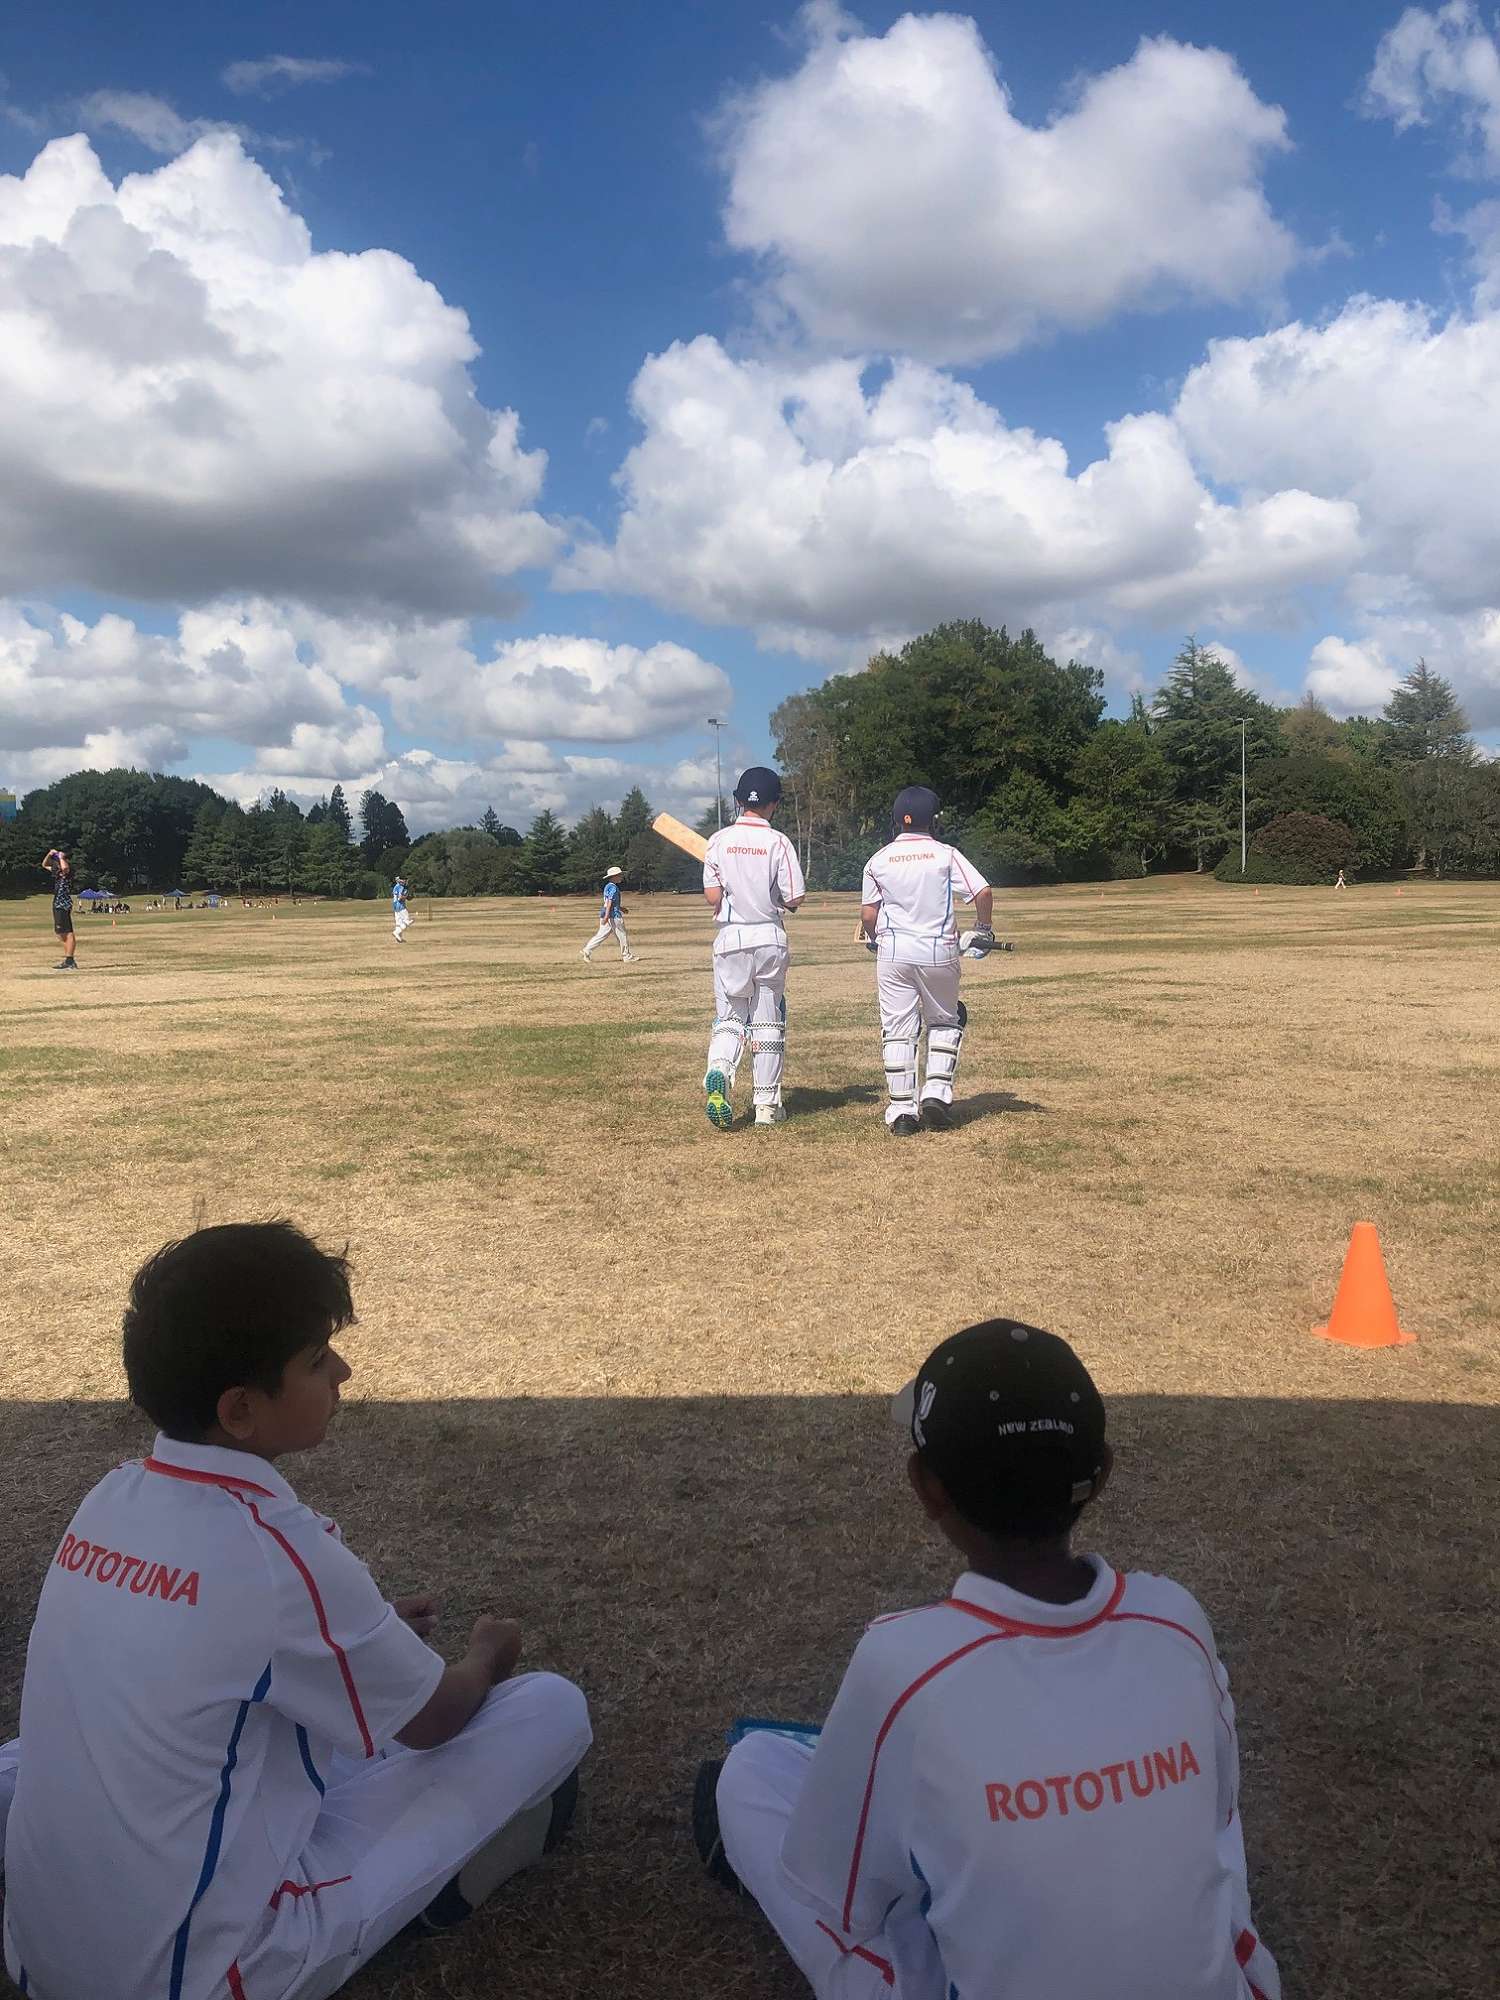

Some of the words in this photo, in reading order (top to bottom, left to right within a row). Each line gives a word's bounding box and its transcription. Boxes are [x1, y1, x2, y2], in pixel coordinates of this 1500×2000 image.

[726, 846, 768, 856] ROTOTUNA
[889, 852, 935, 863] ROTOTUNA
[998, 1420, 1026, 1436] NEW
[56, 1533, 200, 1606] ROTOTUNA
[984, 1740, 1201, 1822] ROTOTUNA
